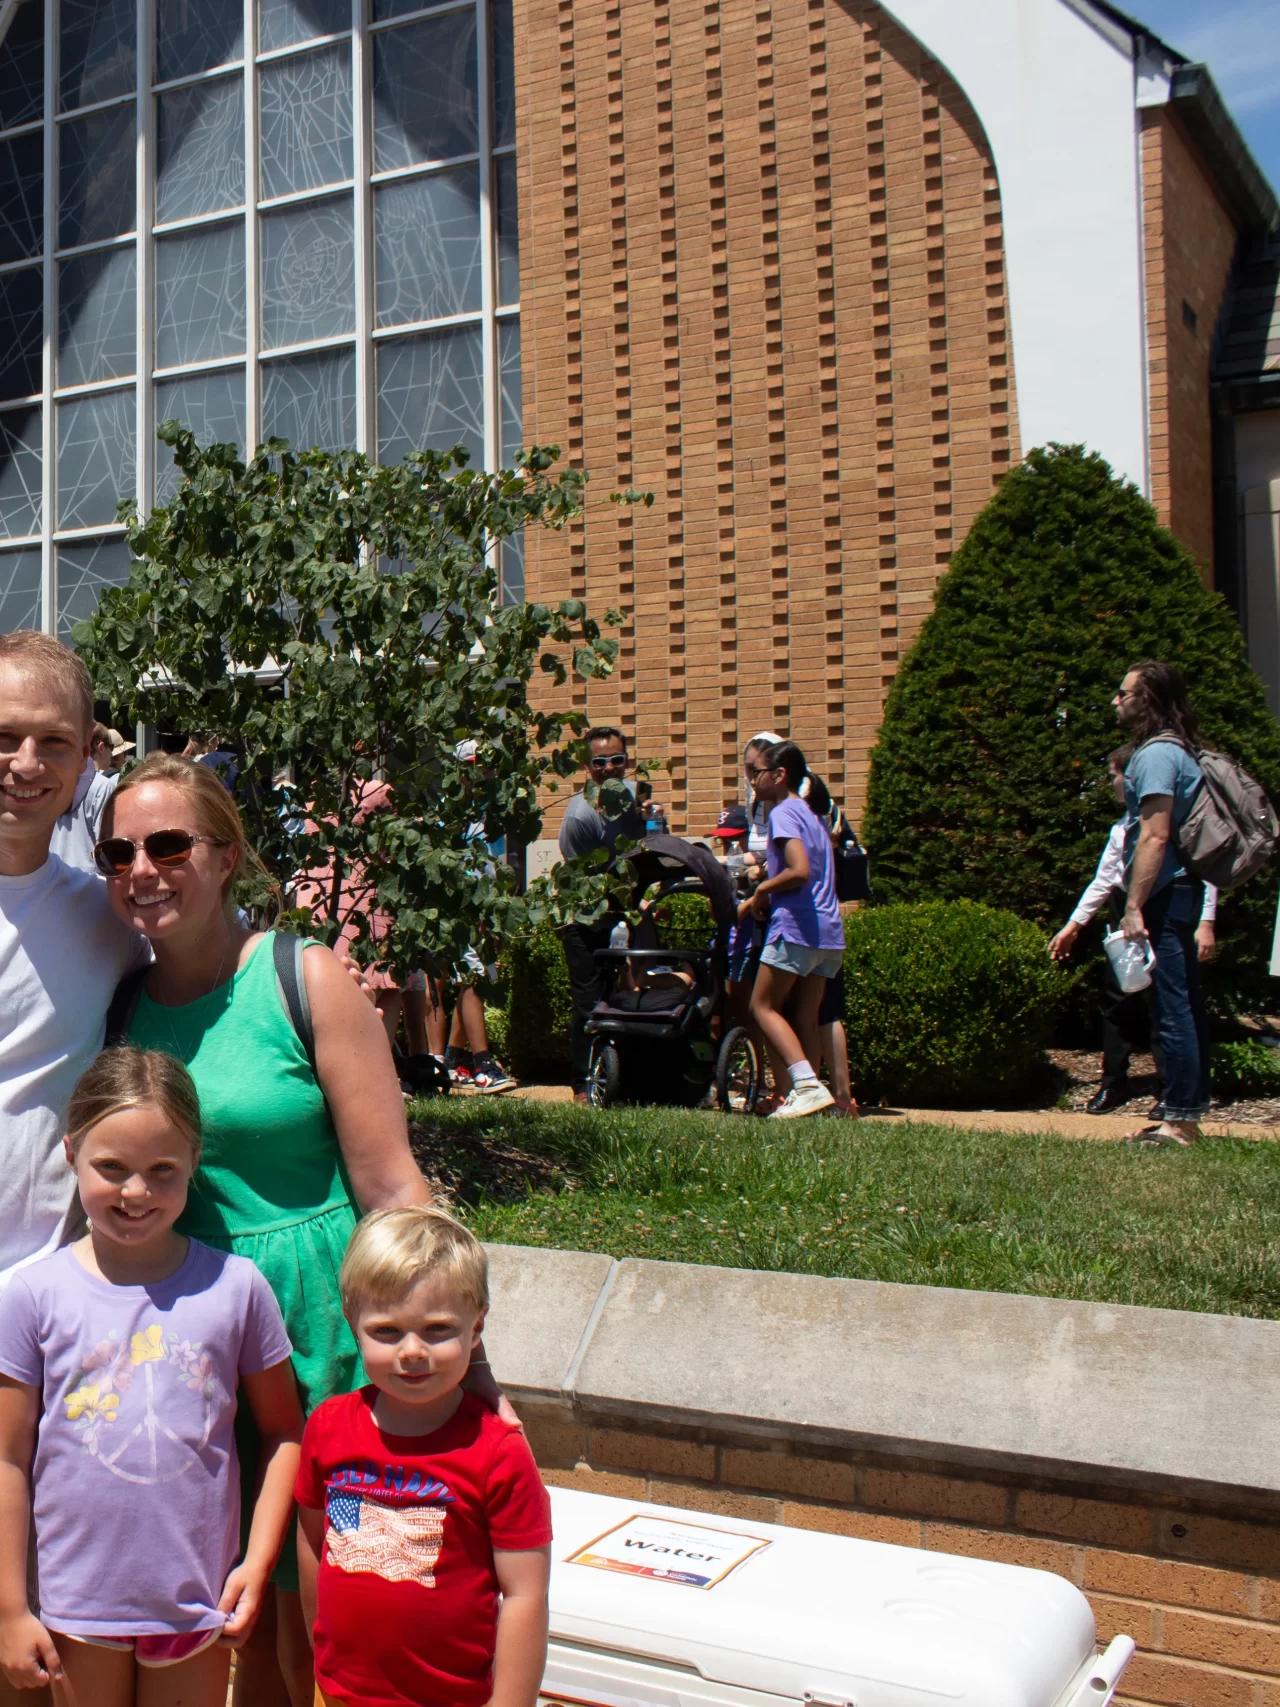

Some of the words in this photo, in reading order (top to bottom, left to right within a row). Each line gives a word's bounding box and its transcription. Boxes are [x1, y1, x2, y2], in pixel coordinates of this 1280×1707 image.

[536, 850, 553, 863] ST.
[332, 1461, 379, 1487] OLD
[384, 1464, 456, 1502] NAVY
[623, 1538, 721, 1563] Water
